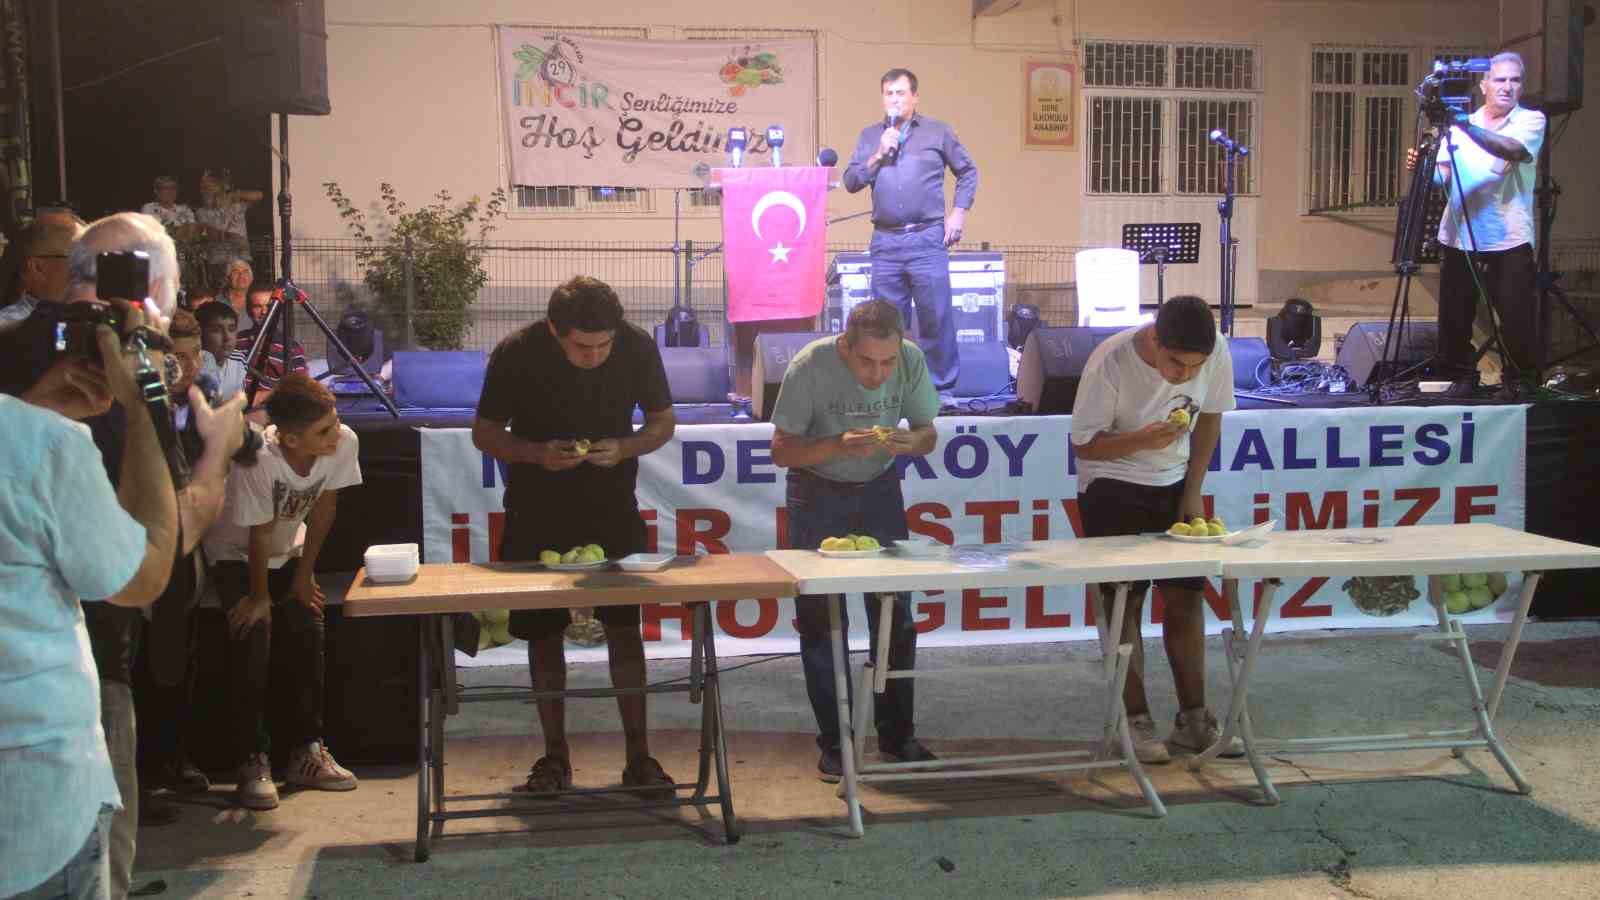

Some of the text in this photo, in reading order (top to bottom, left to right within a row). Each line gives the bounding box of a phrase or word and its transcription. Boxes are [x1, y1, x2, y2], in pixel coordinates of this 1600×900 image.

[549, 59, 567, 76] 29
[620, 91, 738, 117] Şenliğimize
[519, 114, 605, 160] Hoş
